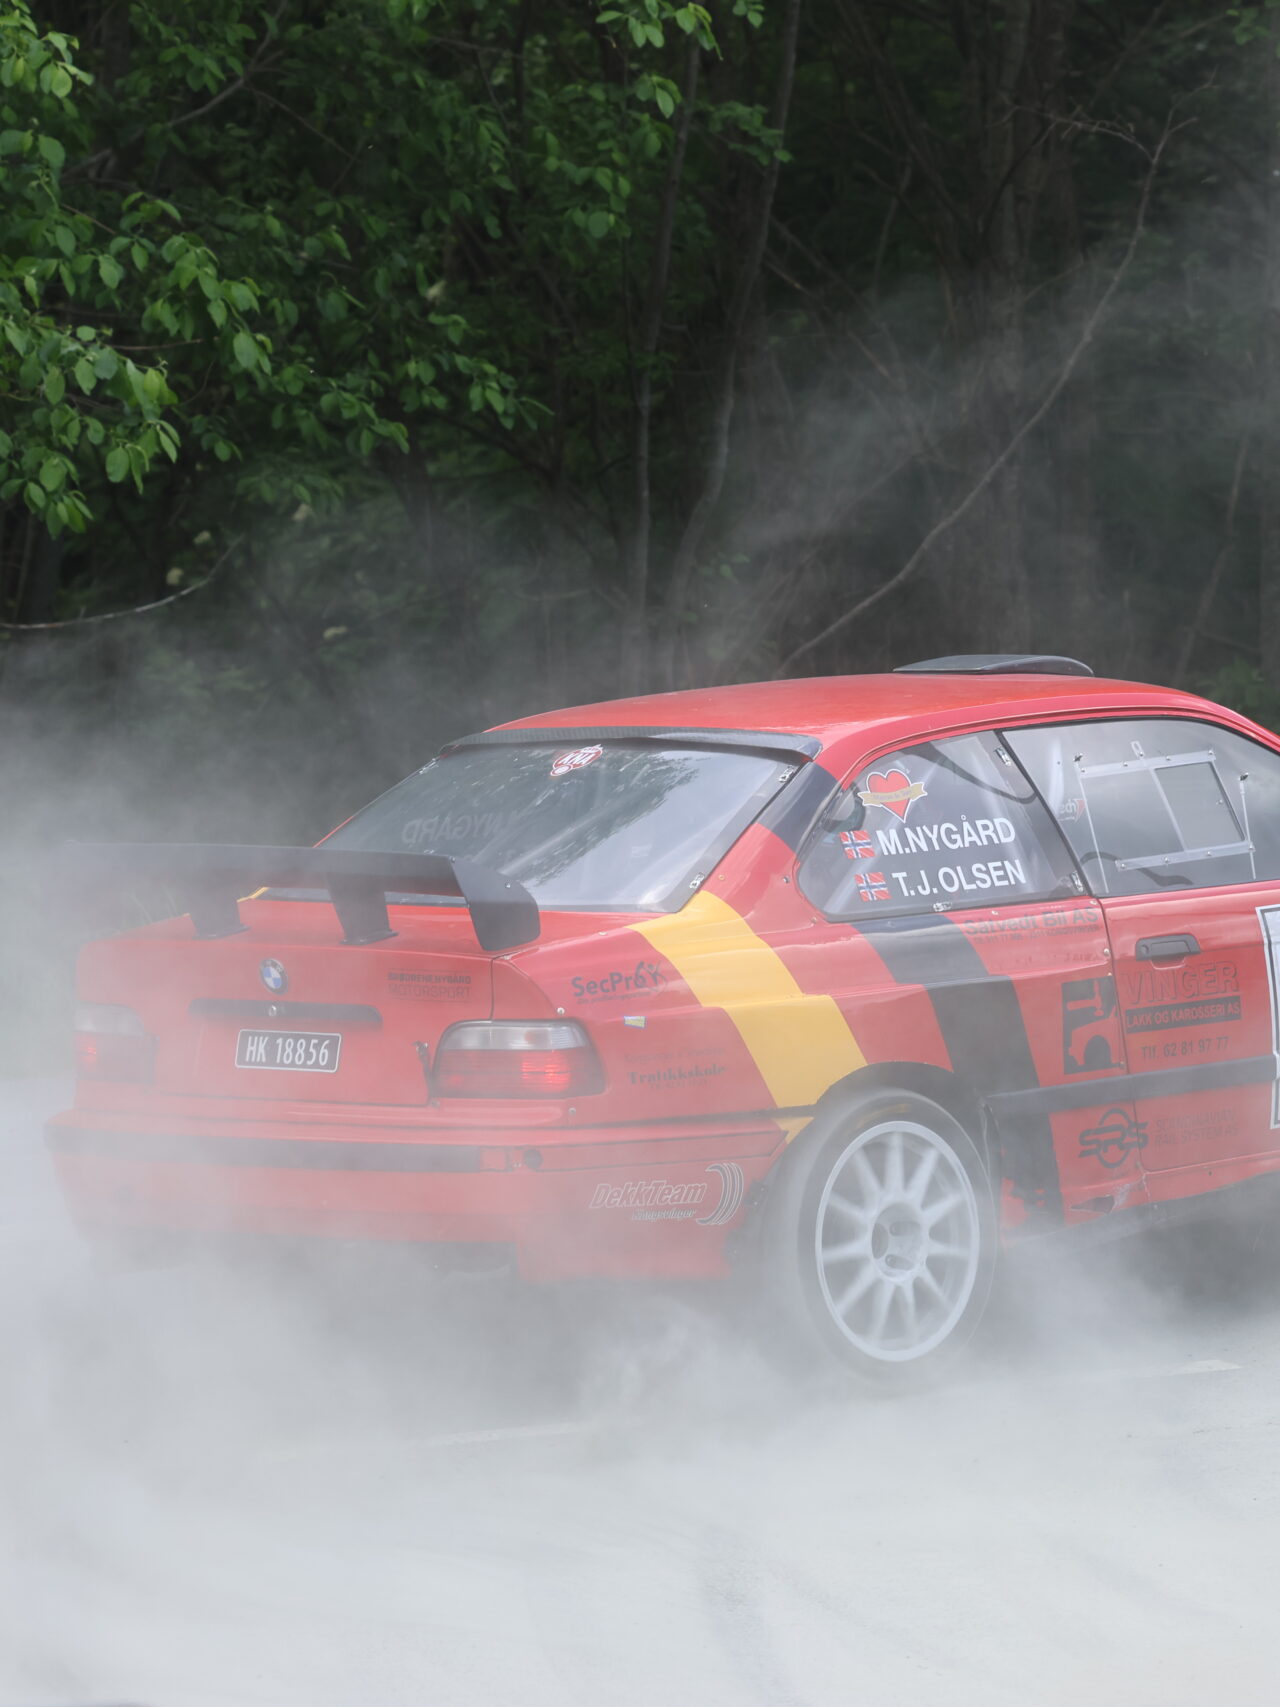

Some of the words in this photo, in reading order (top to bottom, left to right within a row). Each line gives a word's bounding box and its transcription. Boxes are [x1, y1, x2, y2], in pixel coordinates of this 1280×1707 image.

[875, 813, 1017, 857] M.NYGÅRD
[1042, 909, 1067, 928] Bil
[1072, 905, 1099, 926] AS
[1121, 960, 1241, 1005] VINGER
[1127, 1012, 1153, 1029] LAKK
[1154, 1011, 1169, 1026] OG
[1170, 1004, 1225, 1022] KAROSSERI
[1226, 1001, 1241, 1016] AS
[245, 1035, 269, 1063] HK
[276, 1037, 331, 1067] 18856
[1163, 1042, 1178, 1058] 62
[1180, 1040, 1194, 1056] 81
[1198, 1038, 1213, 1054] 97
[1215, 1036, 1230, 1051] 77
[1078, 1120, 1149, 1158] SRS
[589, 1180, 708, 1209] DekkTeam
